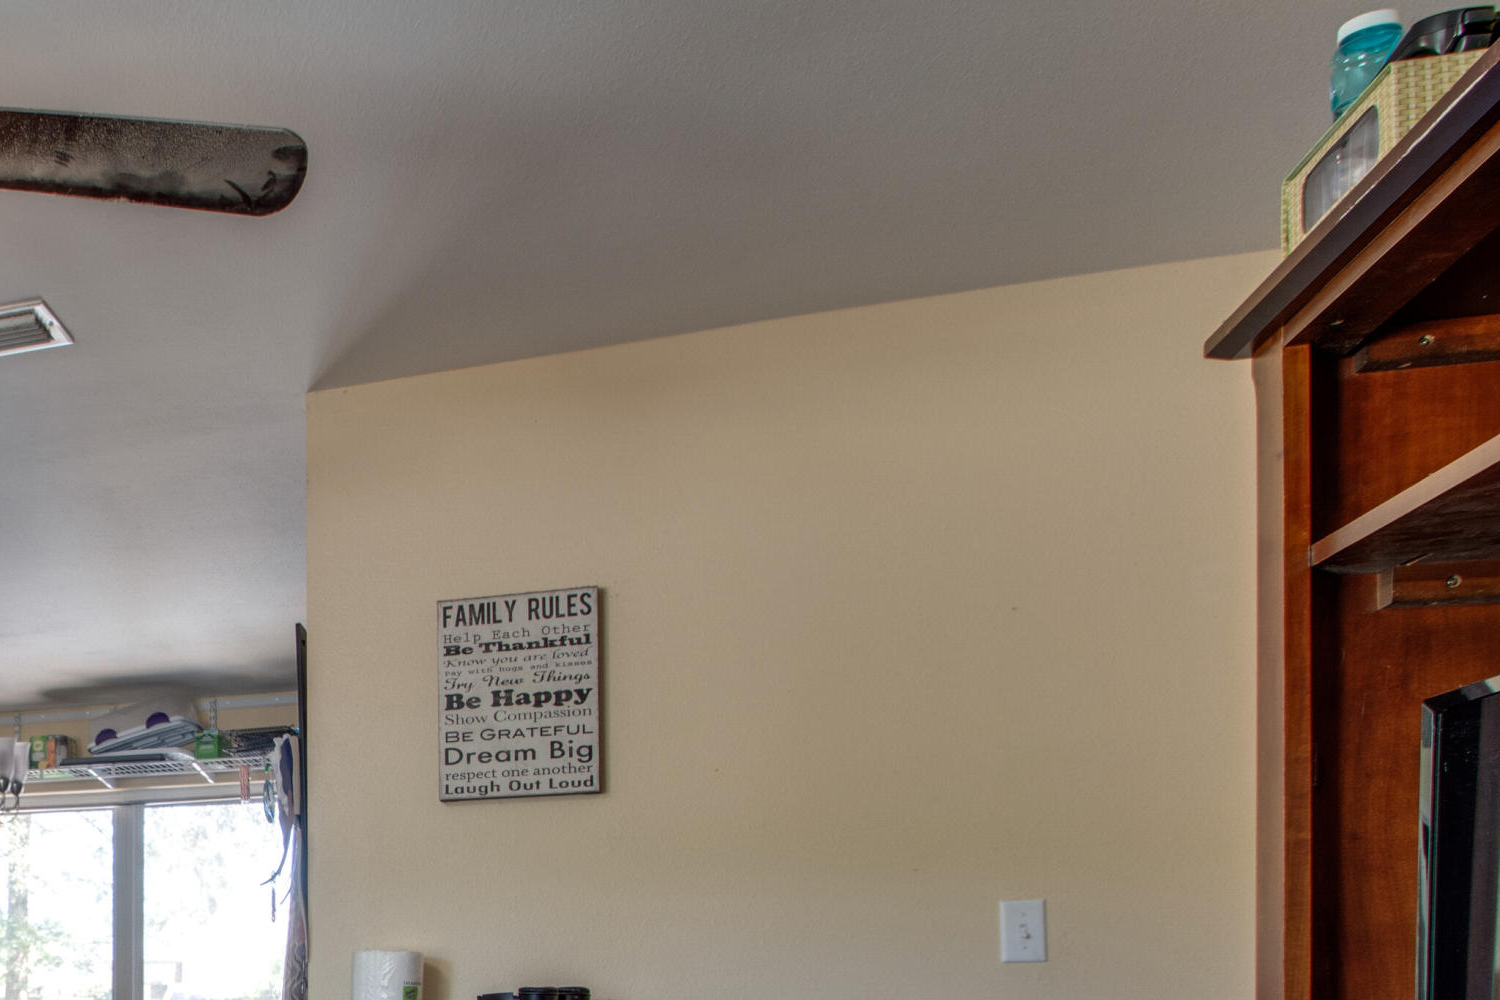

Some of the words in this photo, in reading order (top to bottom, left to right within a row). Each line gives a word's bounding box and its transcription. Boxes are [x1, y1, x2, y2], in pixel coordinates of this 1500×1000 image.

[442, 599, 517, 629] FAMILY
[527, 592, 593, 621] RULES
[443, 632, 481, 645] Help
[492, 629, 530, 640] Each
[541, 623, 591, 636] Other
[443, 645, 474, 657] Be
[478, 633, 592, 653] Thankful
[443, 659, 486, 668] Know
[492, 656, 518, 666] you
[523, 653, 547, 662] are
[552, 646, 594, 660] loved
[530, 662, 549, 670] and
[443, 677, 474, 693] Try
[482, 675, 523, 688] New
[532, 669, 591, 685] Things
[444, 693, 481, 711] Be
[490, 687, 593, 708] Happy
[444, 713, 488, 726] Show
[493, 705, 592, 723] Compassion
[445, 731, 474, 743] BE
[480, 724, 594, 741] GRATEFUL
[444, 747, 537, 766] Dream
[549, 739, 593, 763] Big
[445, 769, 497, 782] respect
[501, 767, 529, 777] one
[533, 762, 593, 776] another
[445, 780, 501, 796] Laugh
[508, 780, 541, 792] Out
[548, 774, 594, 790] Loud
